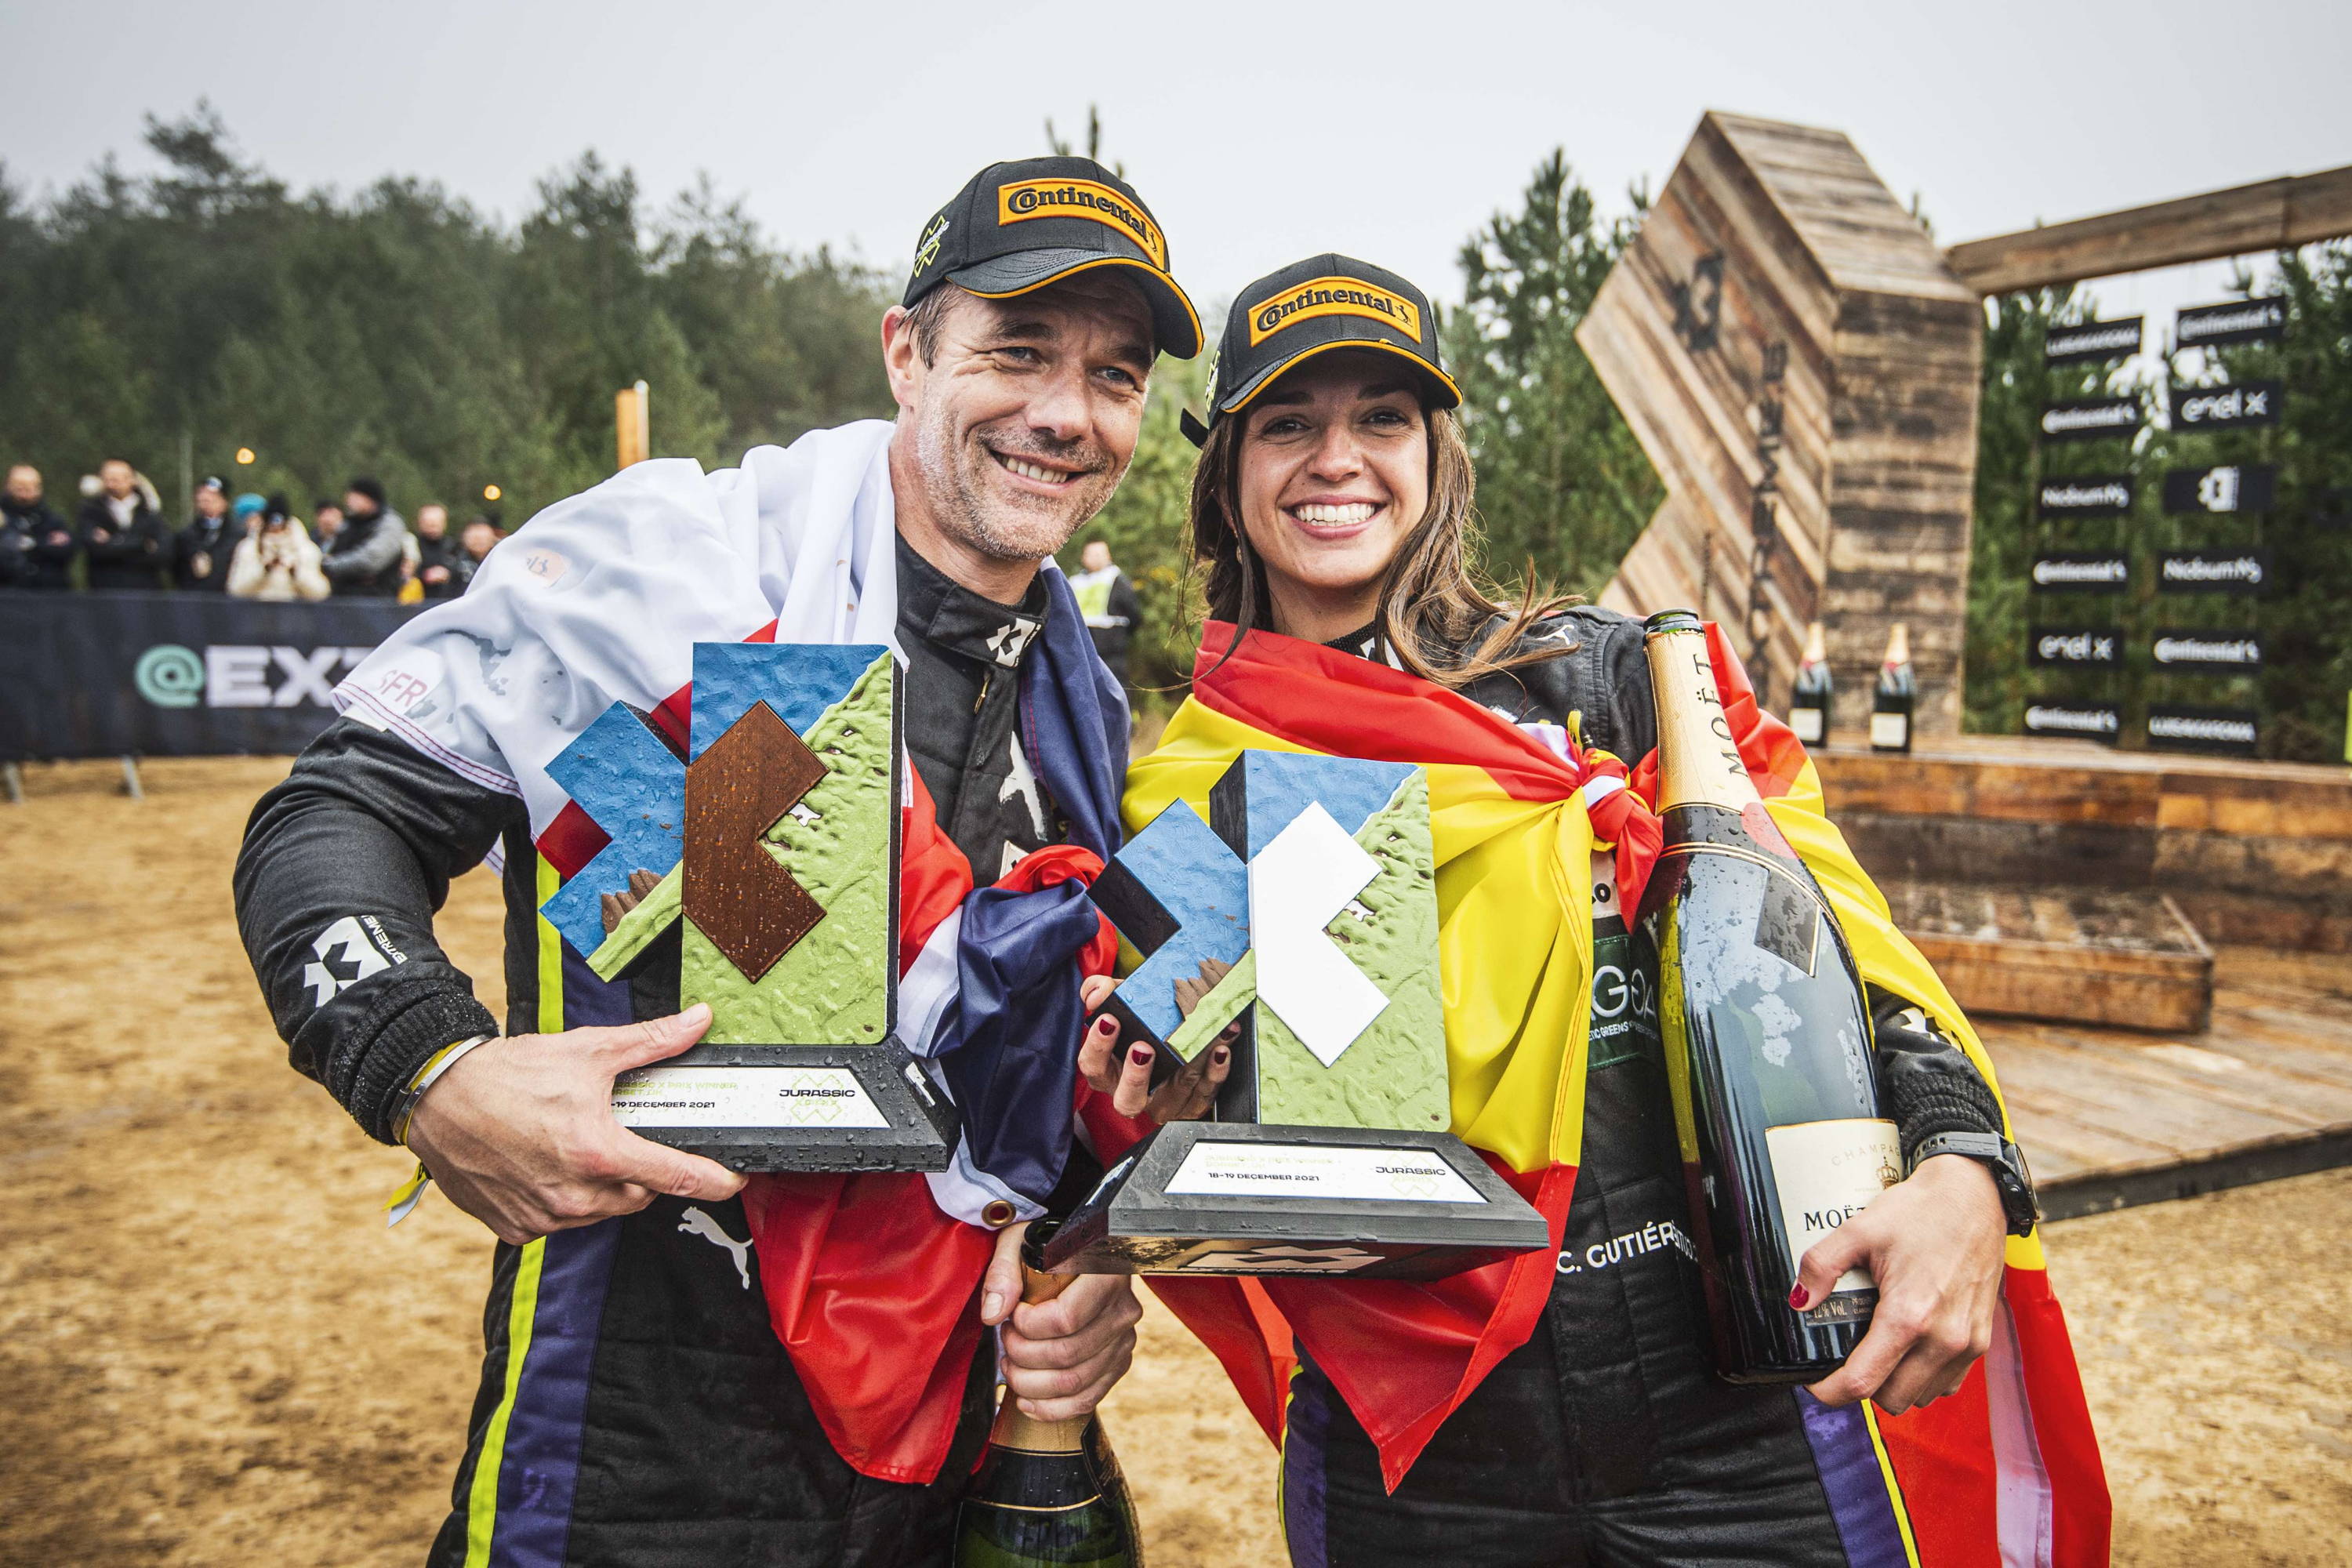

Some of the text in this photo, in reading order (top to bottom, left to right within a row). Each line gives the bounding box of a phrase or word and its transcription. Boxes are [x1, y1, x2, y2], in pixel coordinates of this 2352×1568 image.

[1008, 187, 1149, 242] Continental
[1257, 289, 1396, 332] Continental
[1600, 1021, 1628, 1037] GREENS
[779, 1089, 856, 1098] JURASSIC
[1375, 1166, 1446, 1176] JURASSIC
[1803, 1204, 1867, 1231] MOË
[1555, 1250, 1582, 1273] C.
